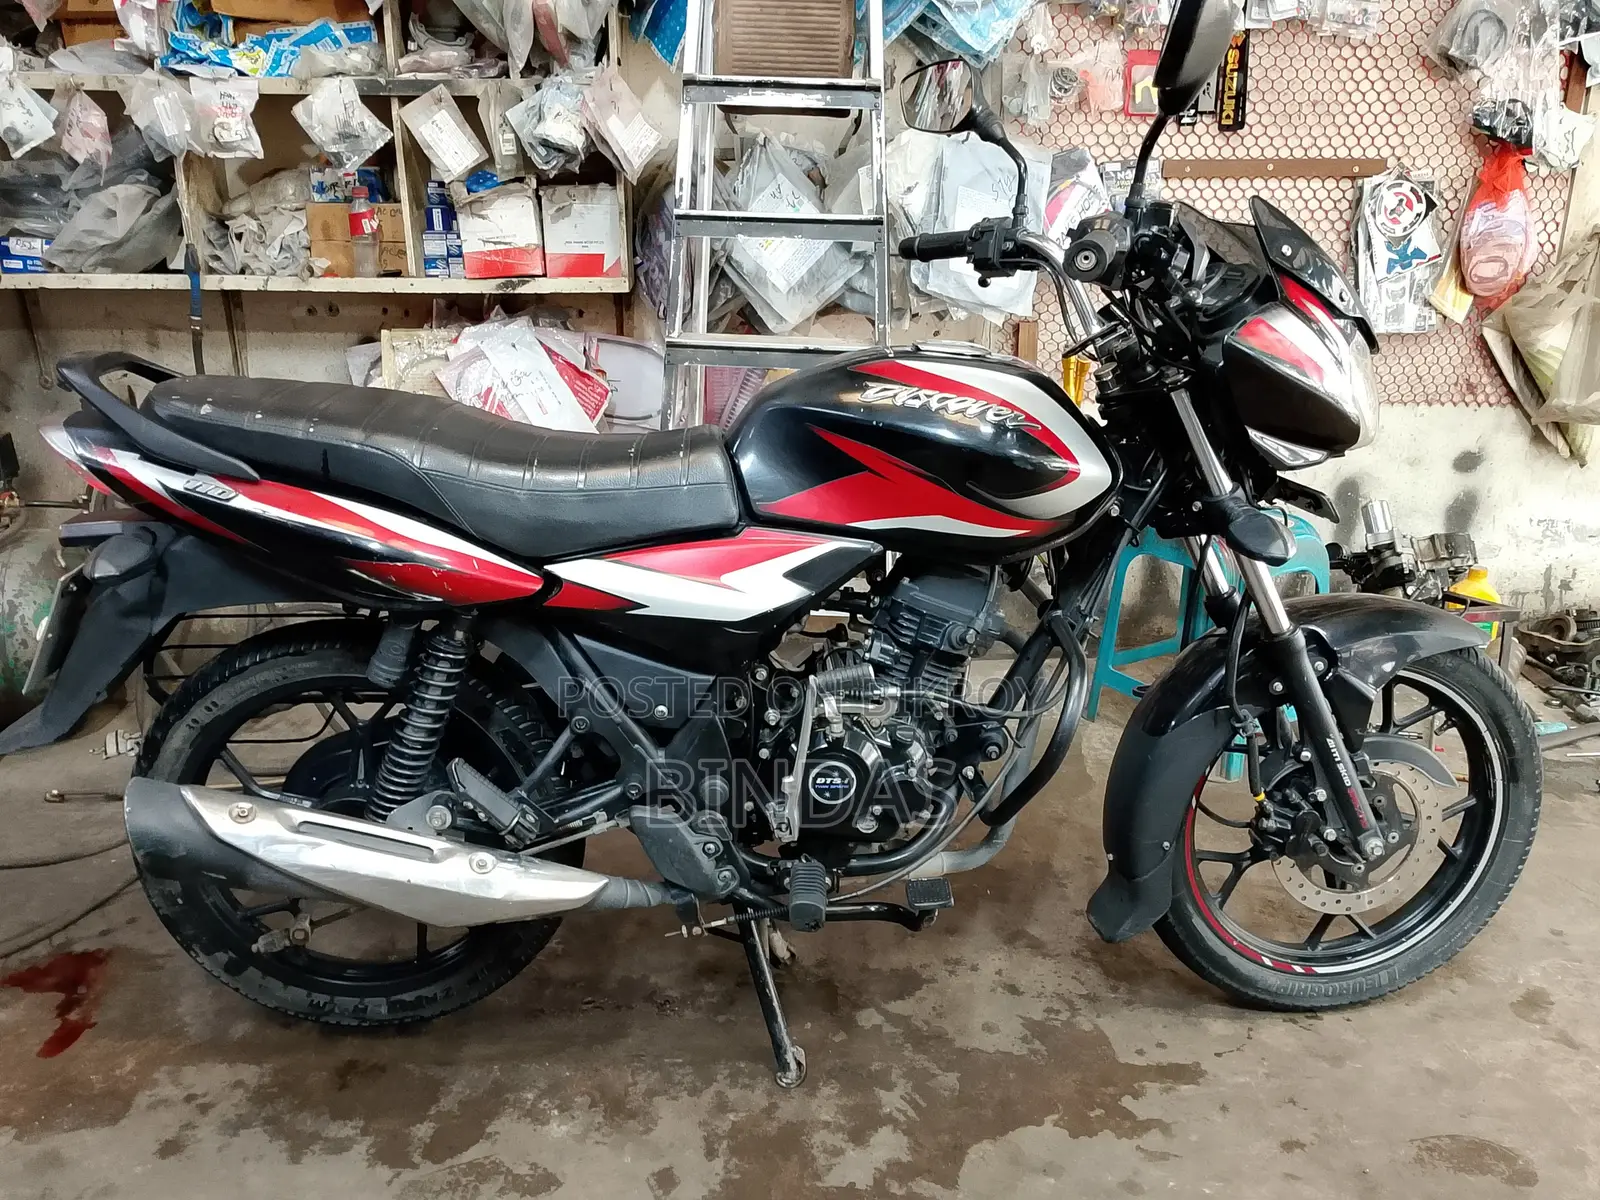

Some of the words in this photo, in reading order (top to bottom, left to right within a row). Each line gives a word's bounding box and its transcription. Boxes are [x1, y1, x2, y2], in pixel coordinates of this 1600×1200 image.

[1221, 48, 1240, 125] SUZUKI
[857, 381, 1042, 431] Discover
[184, 480, 236, 500] 110
[1337, 761, 1352, 787] SKID
